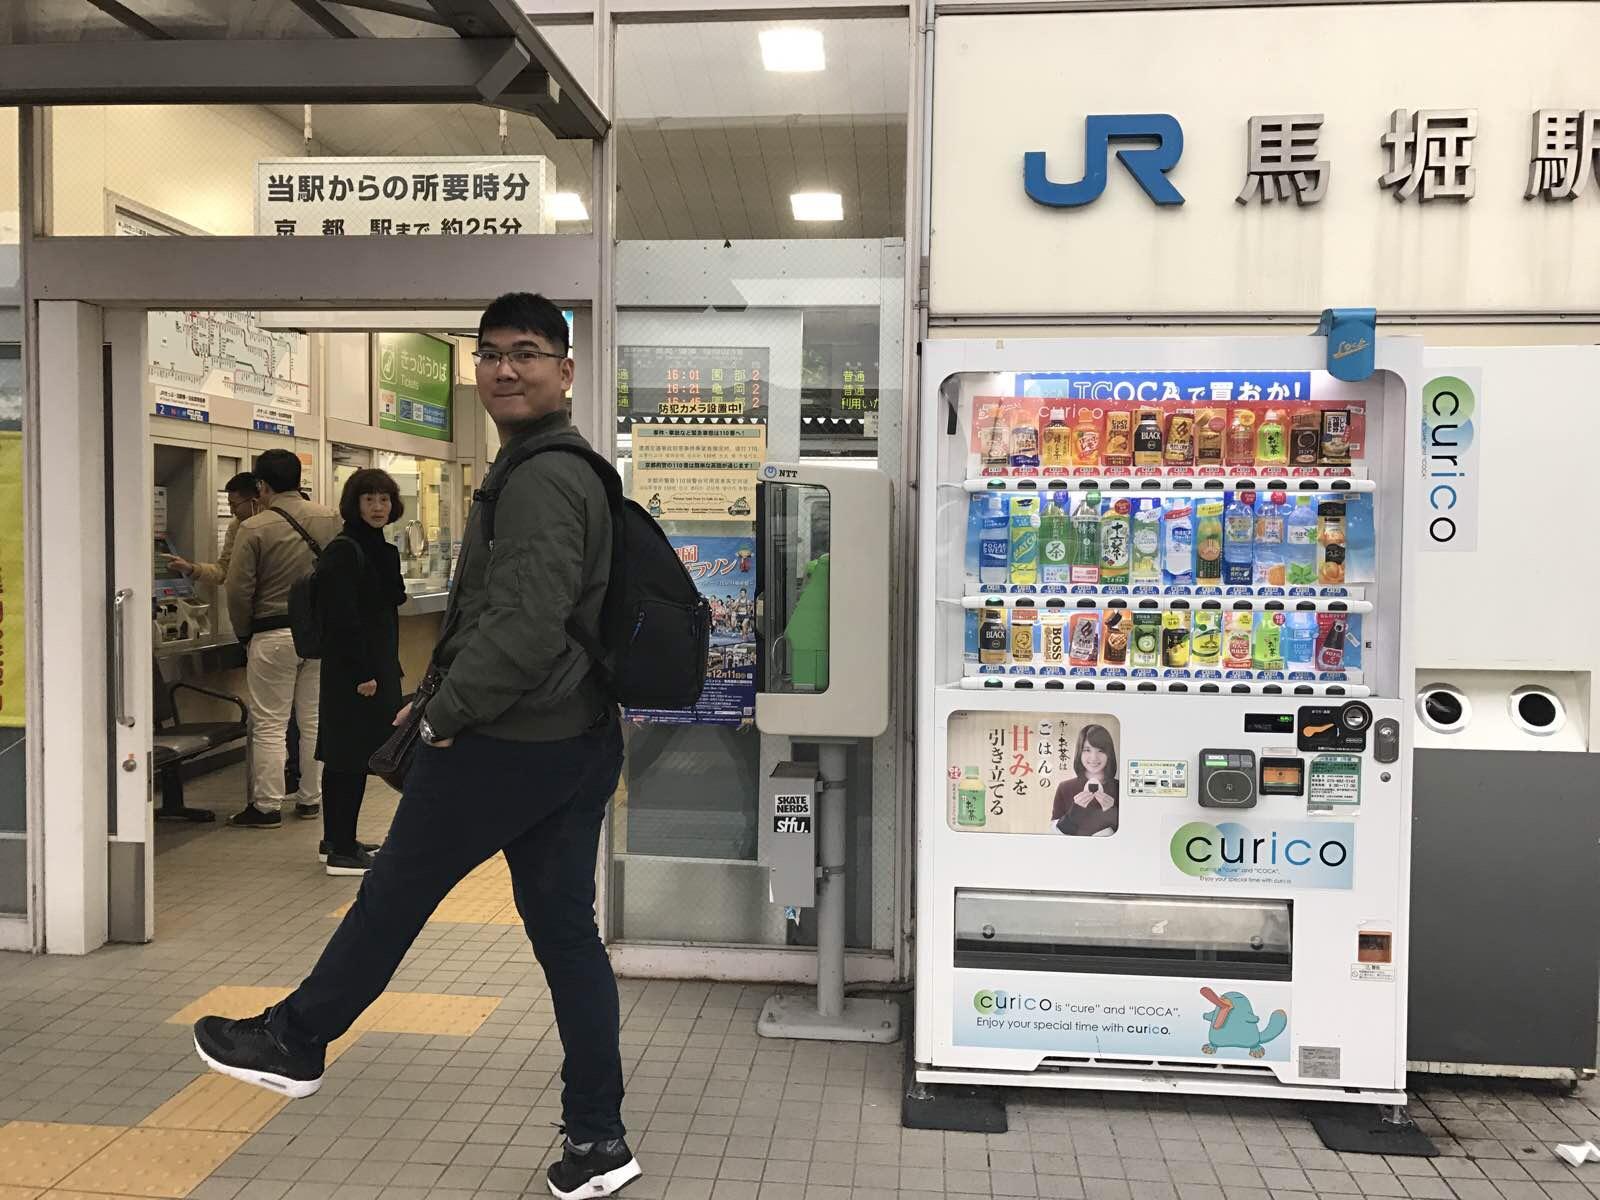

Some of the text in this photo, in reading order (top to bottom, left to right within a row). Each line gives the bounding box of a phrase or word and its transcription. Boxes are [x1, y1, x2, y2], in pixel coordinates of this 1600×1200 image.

[1024, 113, 1185, 207] JR
[267, 173, 530, 203] 当駅からの所要時分
[400, 350, 448, 383] きっぷうりば
[667, 368, 700, 380] 16:01
[752, 369, 760, 381] 2
[752, 384, 760, 394] 2
[658, 403, 742, 414] 防犯カメラ設置中!
[752, 397, 760, 408] 2
[1141, 430, 1161, 441] BLACK
[779, 469, 798, 478] NTT
[1429, 391, 1465, 542] curico
[986, 630, 1006, 640] BLACK
[1052, 627, 1062, 661] BOSS
[1009, 724, 1034, 796] 甘みを
[1038, 723, 1053, 788] ごはんの
[988, 728, 1006, 816] 引き立てる
[776, 804, 809, 813] NERDS
[777, 796, 807, 805] SKATE
[1185, 831, 1347, 867] curico
[980, 994, 1181, 1017] curico is "cure" and "ICOCA".
[976, 1016, 1005, 1030] Enjoy
[1007, 1020, 1031, 1030] your
[1033, 1020, 1073, 1031] special
[1075, 1021, 1099, 1032] time
[1101, 1022, 1124, 1033] with
